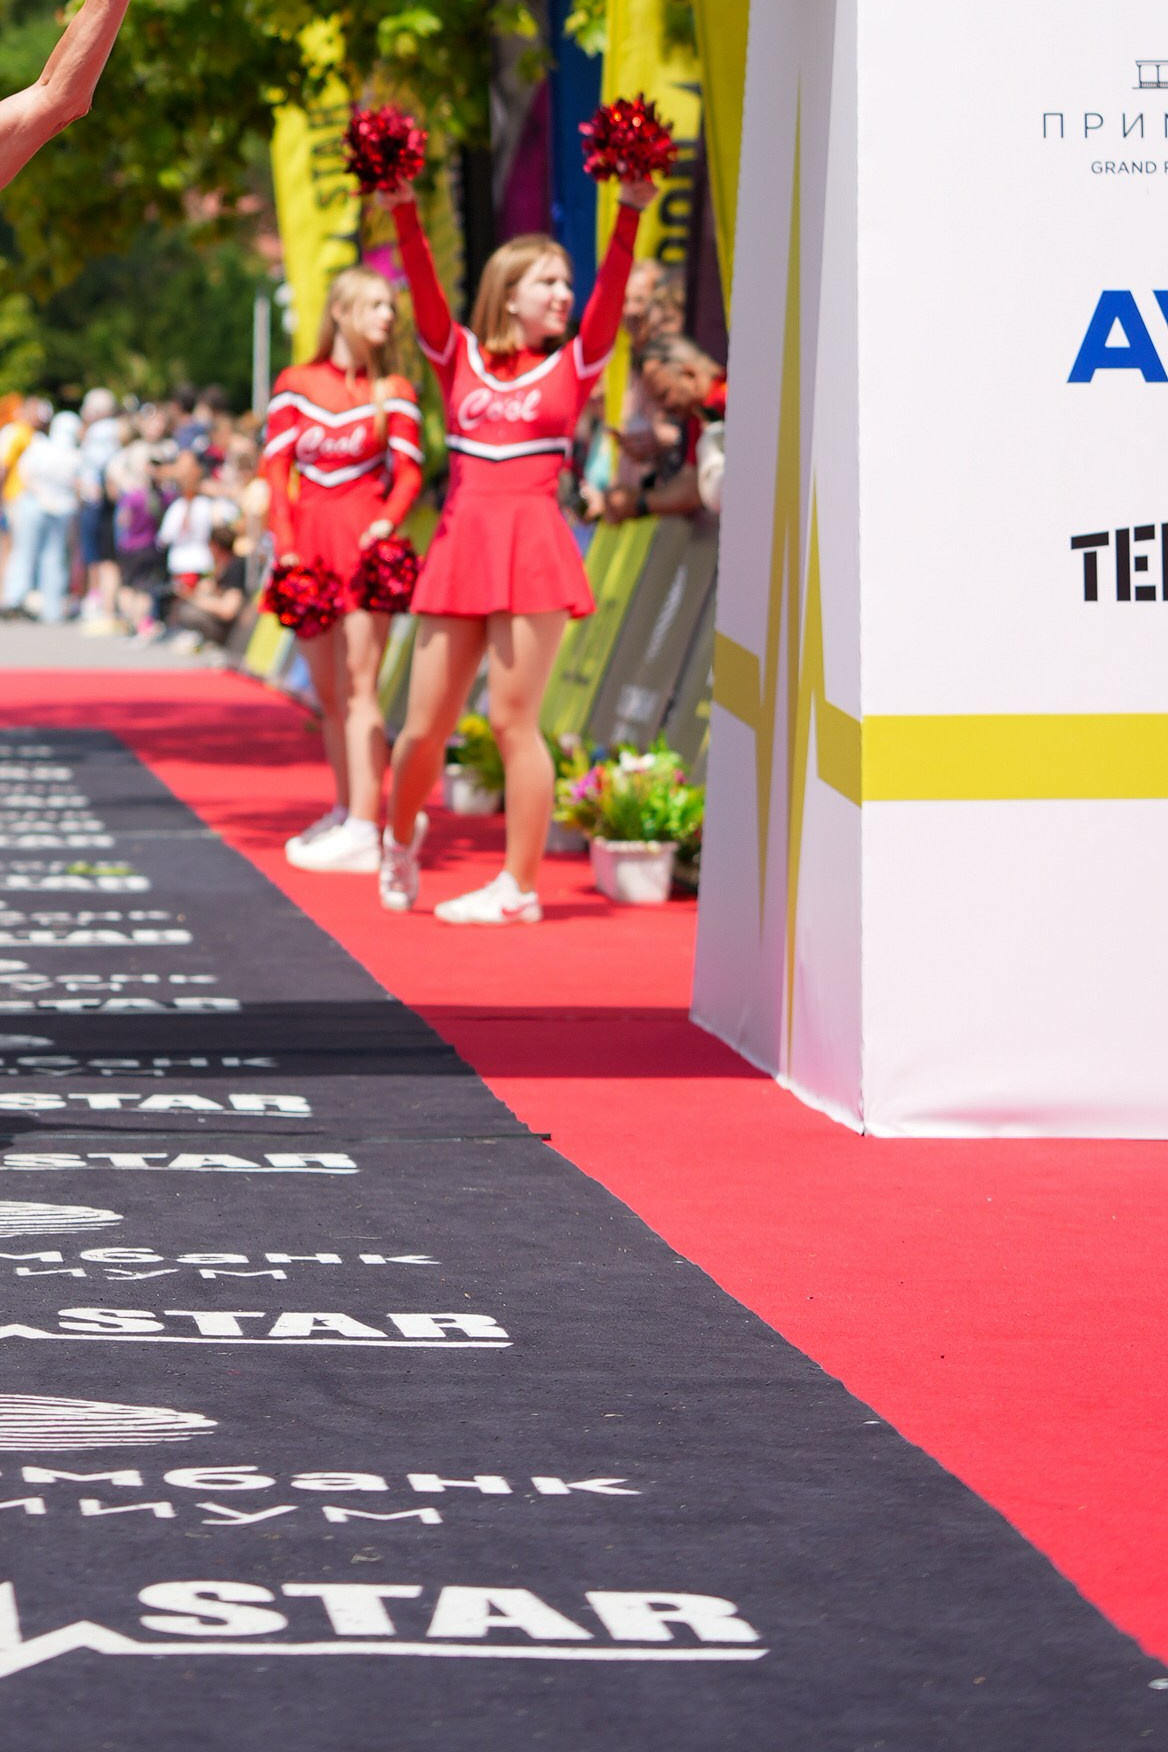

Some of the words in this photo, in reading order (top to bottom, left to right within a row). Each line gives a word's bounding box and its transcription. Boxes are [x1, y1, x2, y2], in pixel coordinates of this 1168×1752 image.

[1043, 112, 1168, 139] ПРИ
[1090, 160, 1158, 175] GRAND
[1069, 520, 1168, 602] TE
[2, 1152, 360, 1173] STAR
[56, 1307, 512, 1339] STAR
[136, 1580, 764, 1643] STAR
